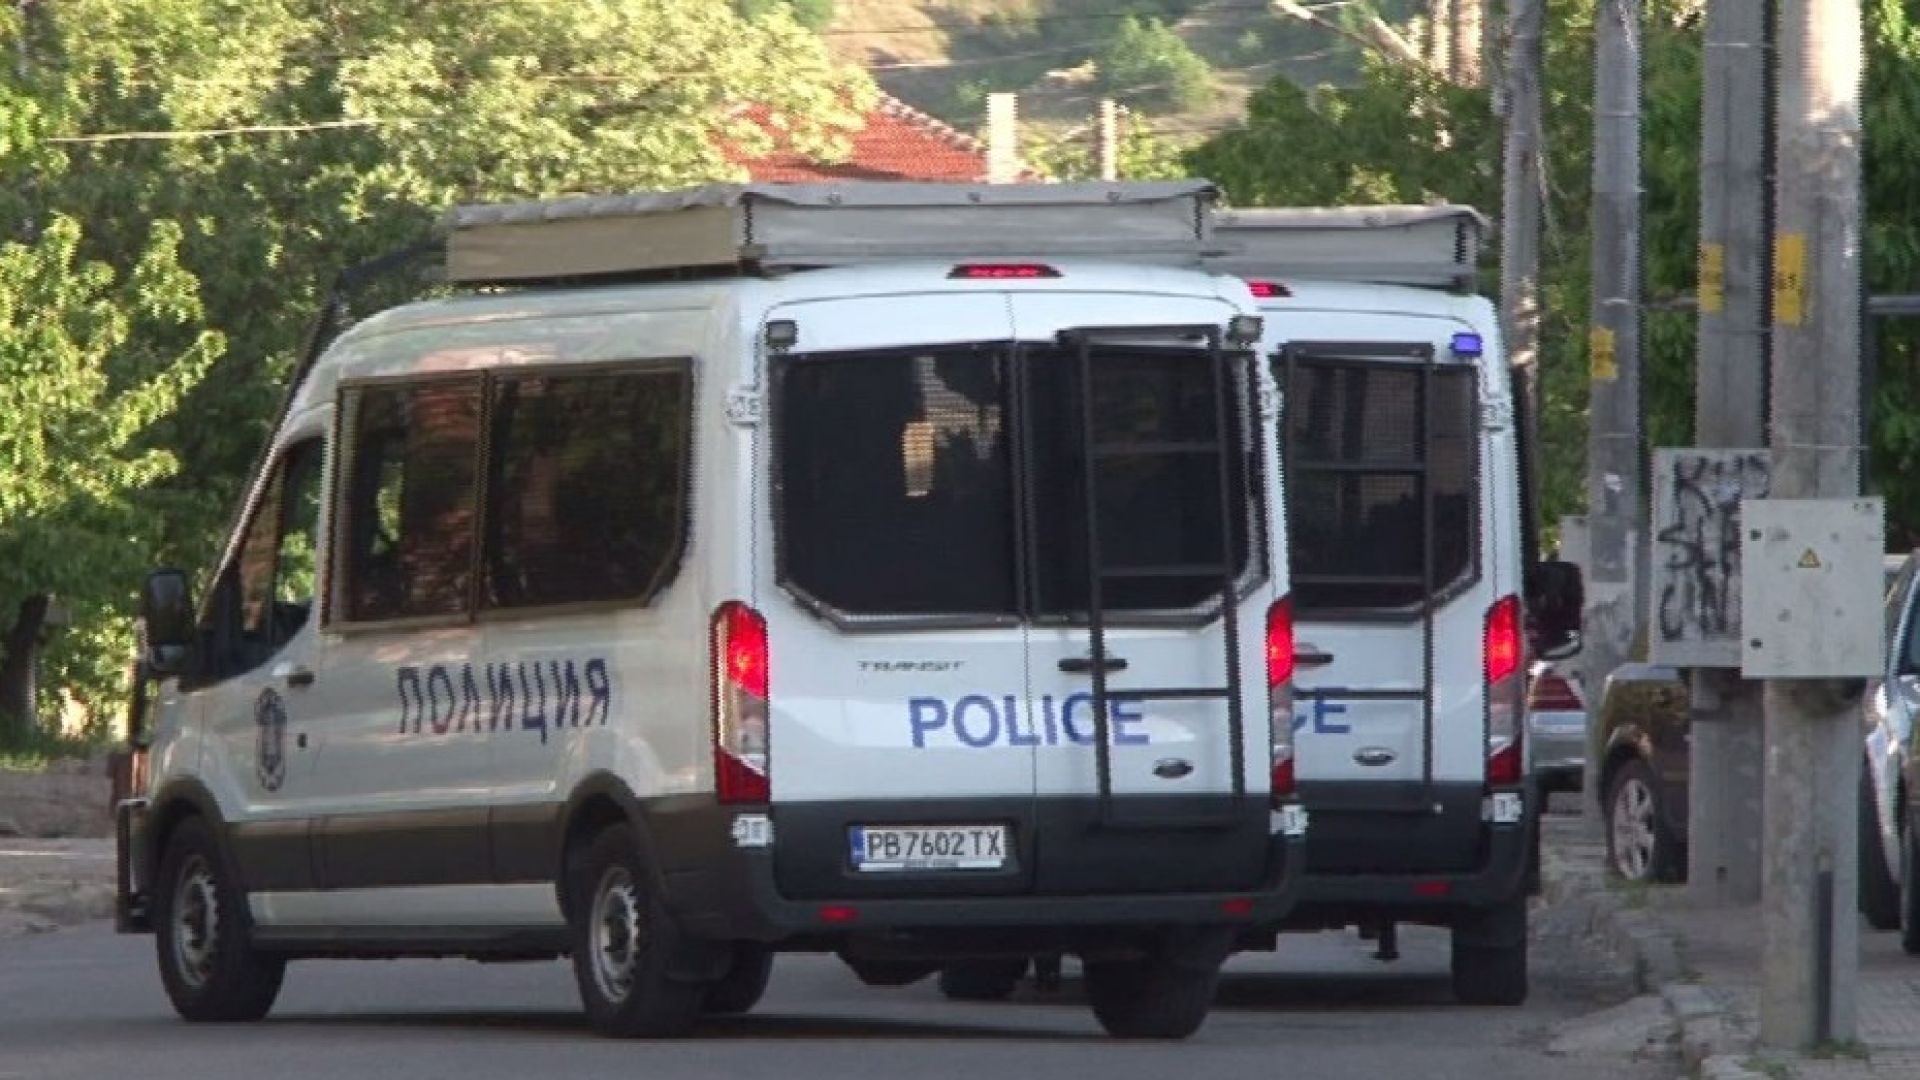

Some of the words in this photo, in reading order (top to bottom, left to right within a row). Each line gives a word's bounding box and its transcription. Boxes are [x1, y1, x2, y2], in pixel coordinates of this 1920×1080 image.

[857, 660, 966, 672] TRANSIT
[398, 659, 610, 744] ПОЛИЦИЯ
[909, 695, 1150, 748] POLICE
